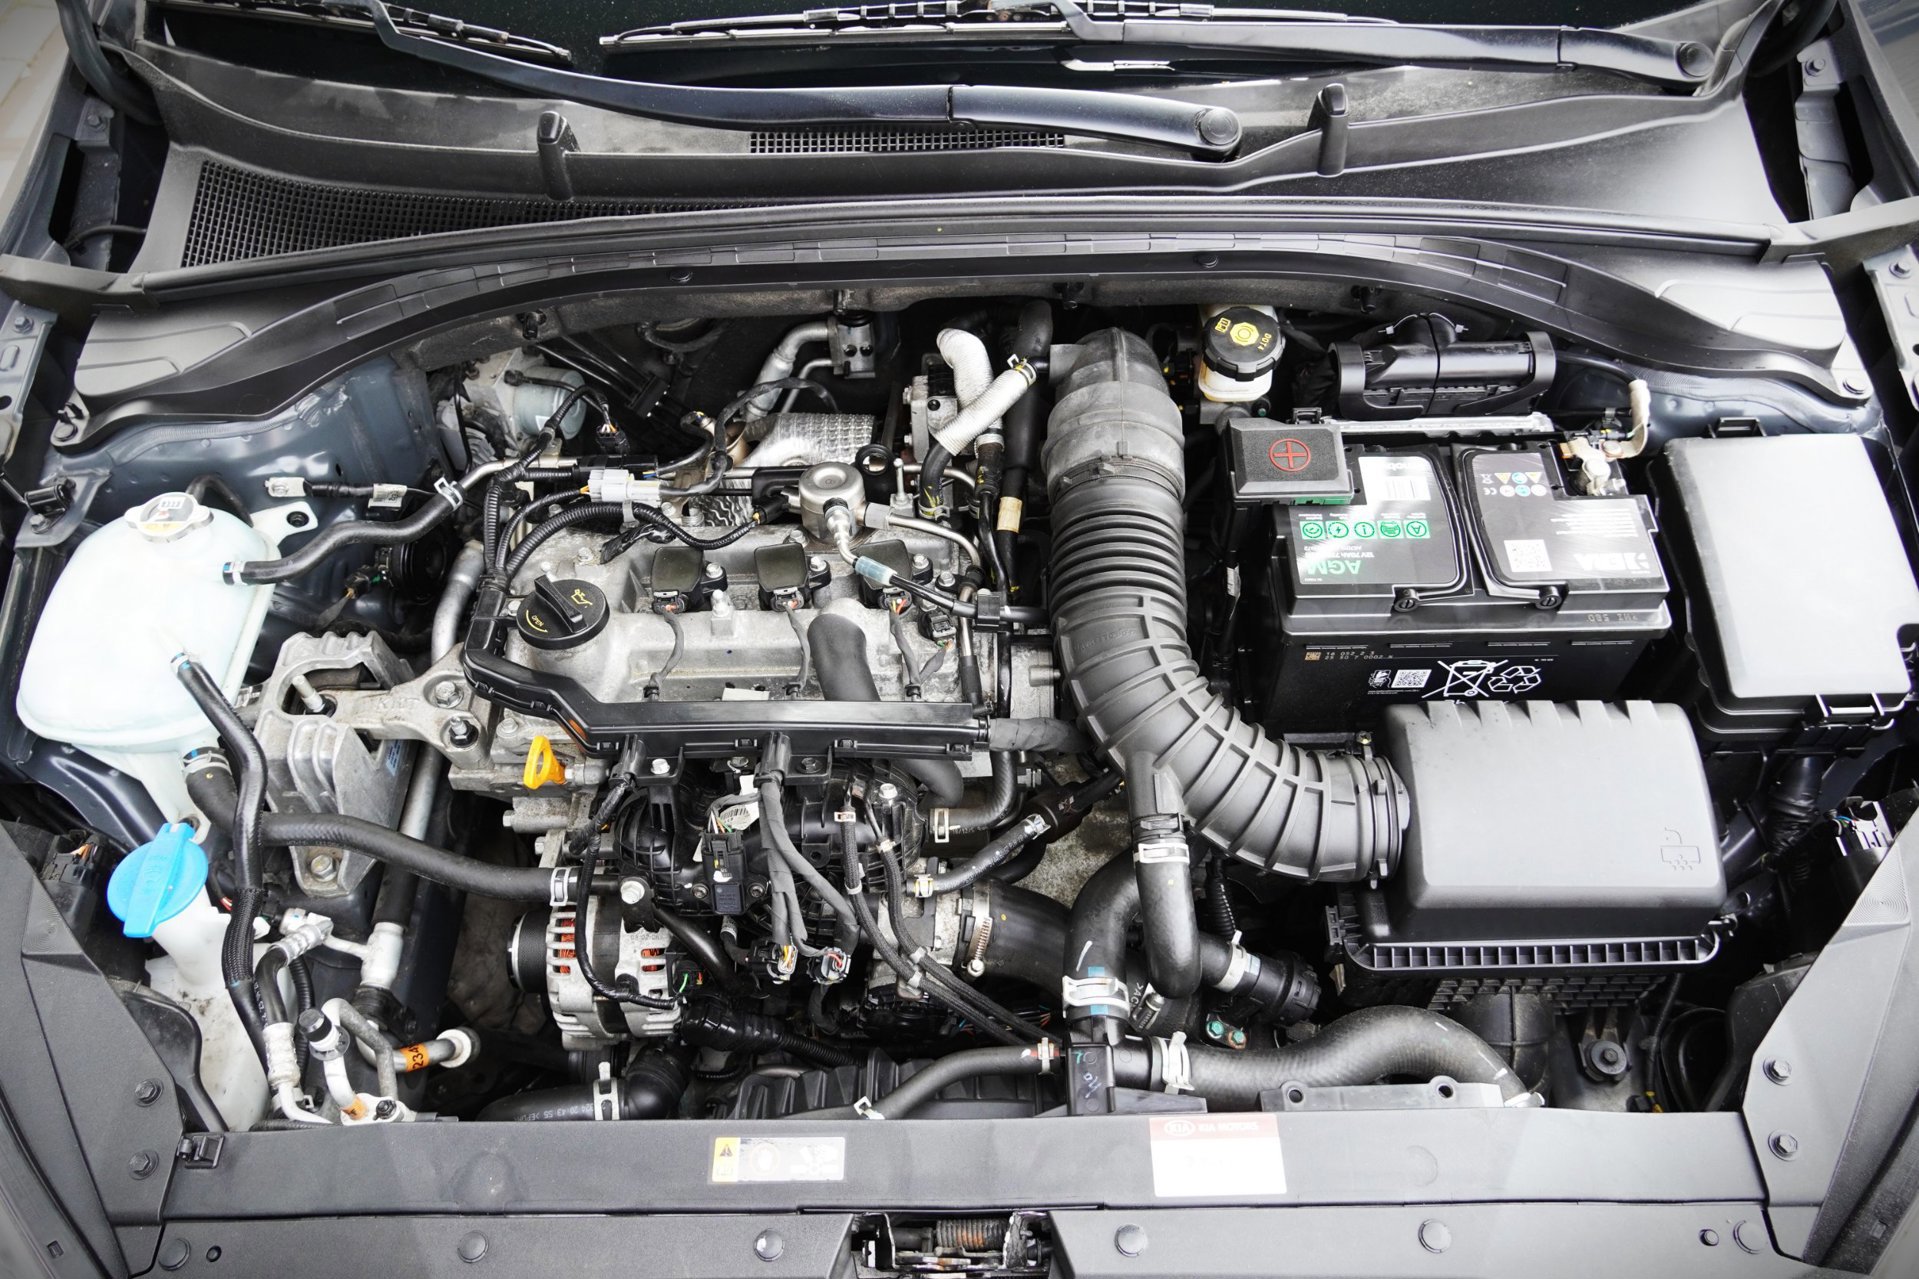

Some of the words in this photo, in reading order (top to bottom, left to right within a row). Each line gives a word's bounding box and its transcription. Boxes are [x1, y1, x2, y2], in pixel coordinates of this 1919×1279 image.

[1257, 332, 1272, 352] DOT4
[1307, 559, 1362, 575] AGM
[531, 615, 545, 627] OPEN
